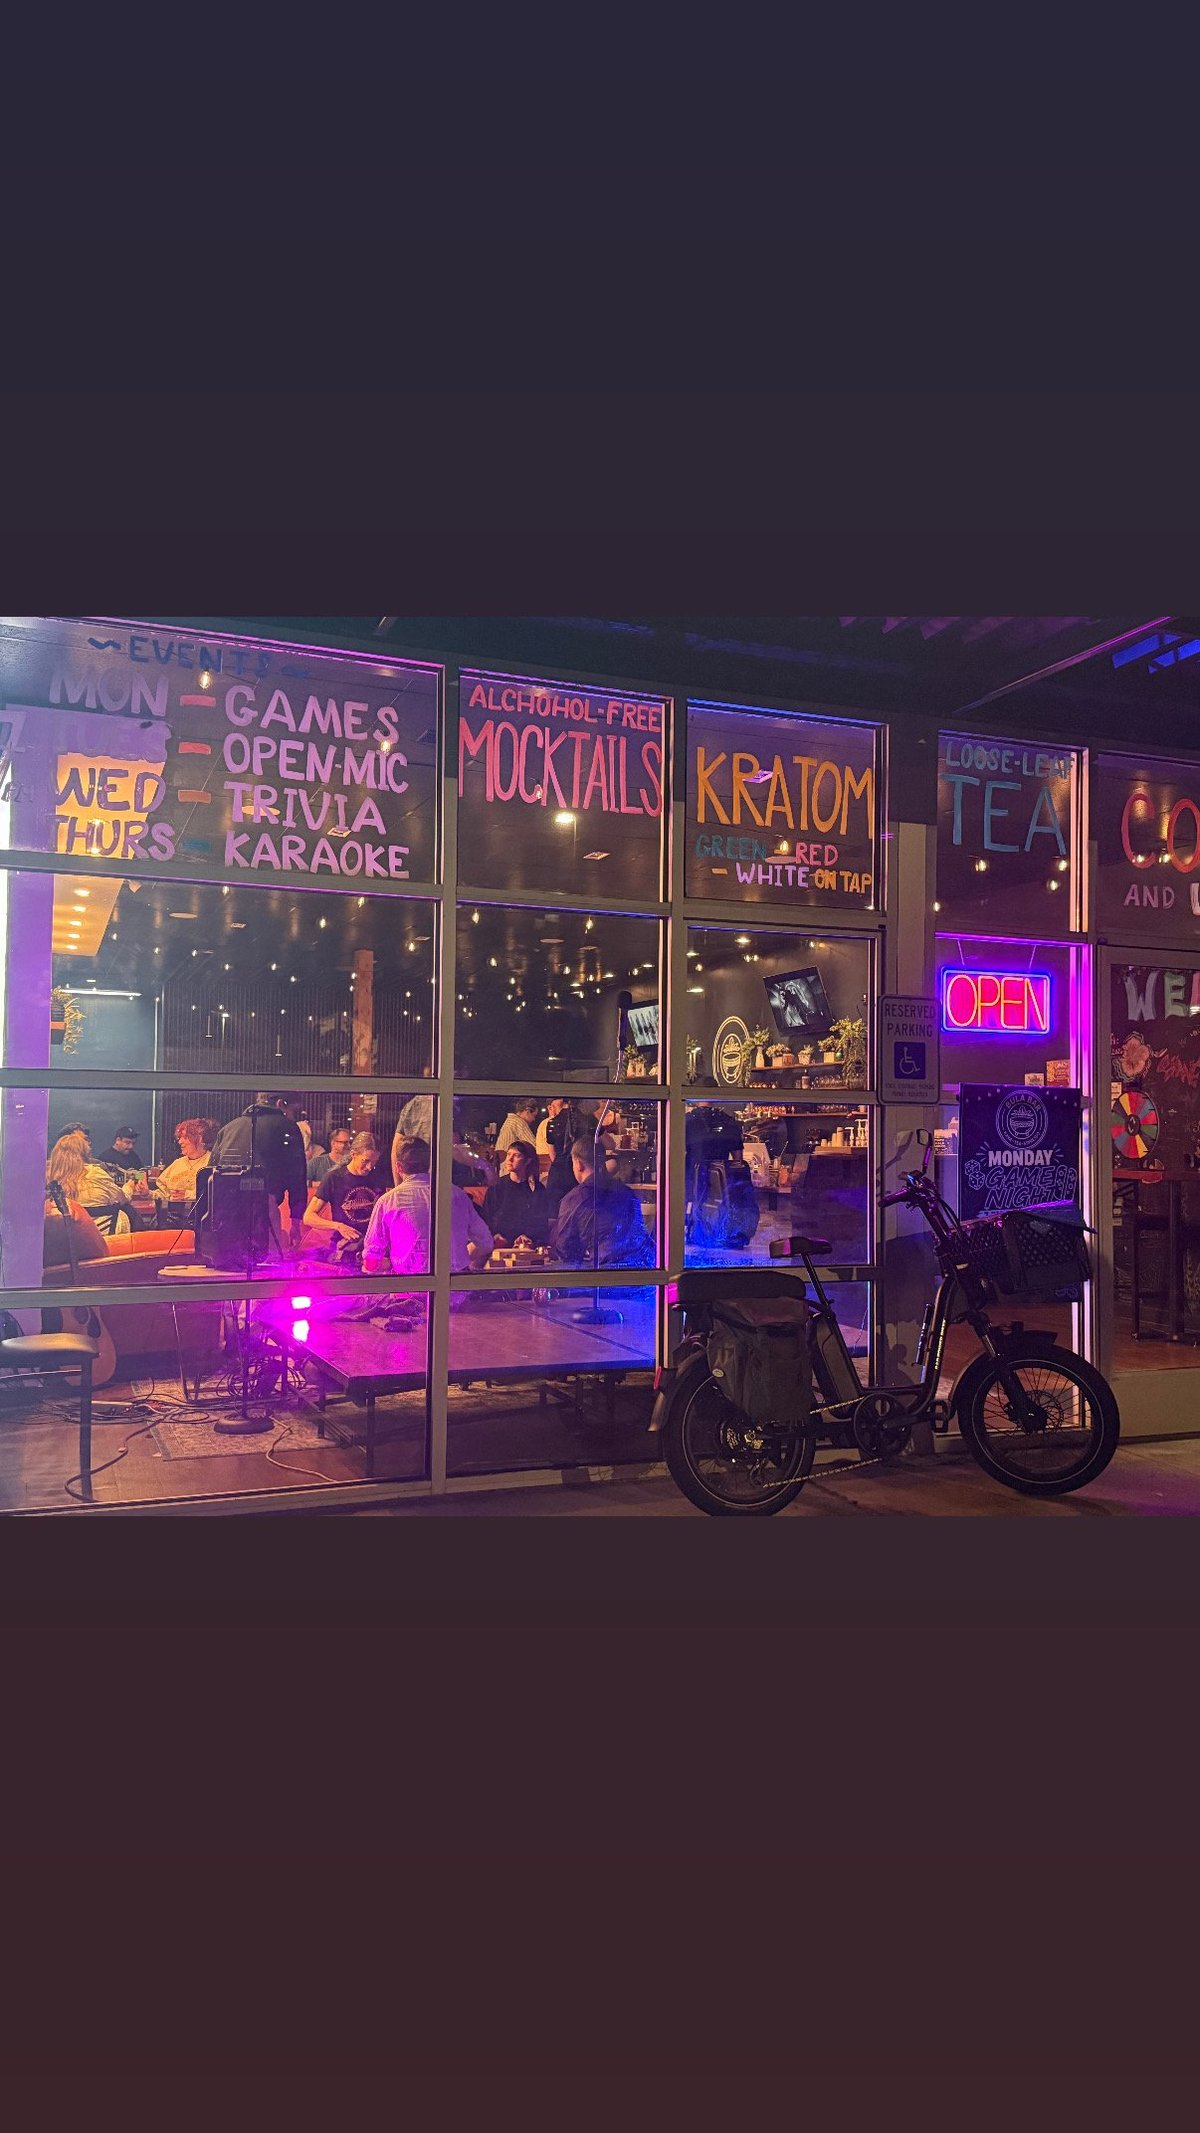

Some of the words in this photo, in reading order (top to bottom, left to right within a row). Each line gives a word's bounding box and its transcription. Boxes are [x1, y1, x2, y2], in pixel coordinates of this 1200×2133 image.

[129, 635, 273, 679] EVENTS
[48, 665, 170, 717] MON
[224, 684, 400, 744] GAMES
[468, 684, 662, 733] ALCHOHOL-FREE
[223, 733, 409, 794] OPEN-MIC
[458, 716, 663, 818] MOCKTAILS
[53, 767, 167, 814] WED
[223, 781, 387, 835] TRIVIA
[696, 746, 874, 839] KRATOM
[942, 773, 1067, 855] TEA
[47, 814, 176, 862] THURS
[224, 831, 411, 880] KARAOKE
[695, 834, 768, 861] GREEN
[795, 842, 839, 867] RED
[735, 862, 810, 888] WHITE
[814, 868, 838, 891] ON
[839, 870, 873, 894] TAP
[1123, 883, 1176, 910] AND
[884, 1003, 936, 1019] RESERVED
[946, 974, 1048, 1031] OPEN
[887, 1022, 933, 1038] PARKING
[1005, 1094, 1026, 1109] BULA
[1027, 1095, 1042, 1112] BAR
[985, 1165, 1056, 1190] GAME
[988, 1149, 1054, 1167] MONDAY
[983, 1186, 1055, 1210] NIGHT
